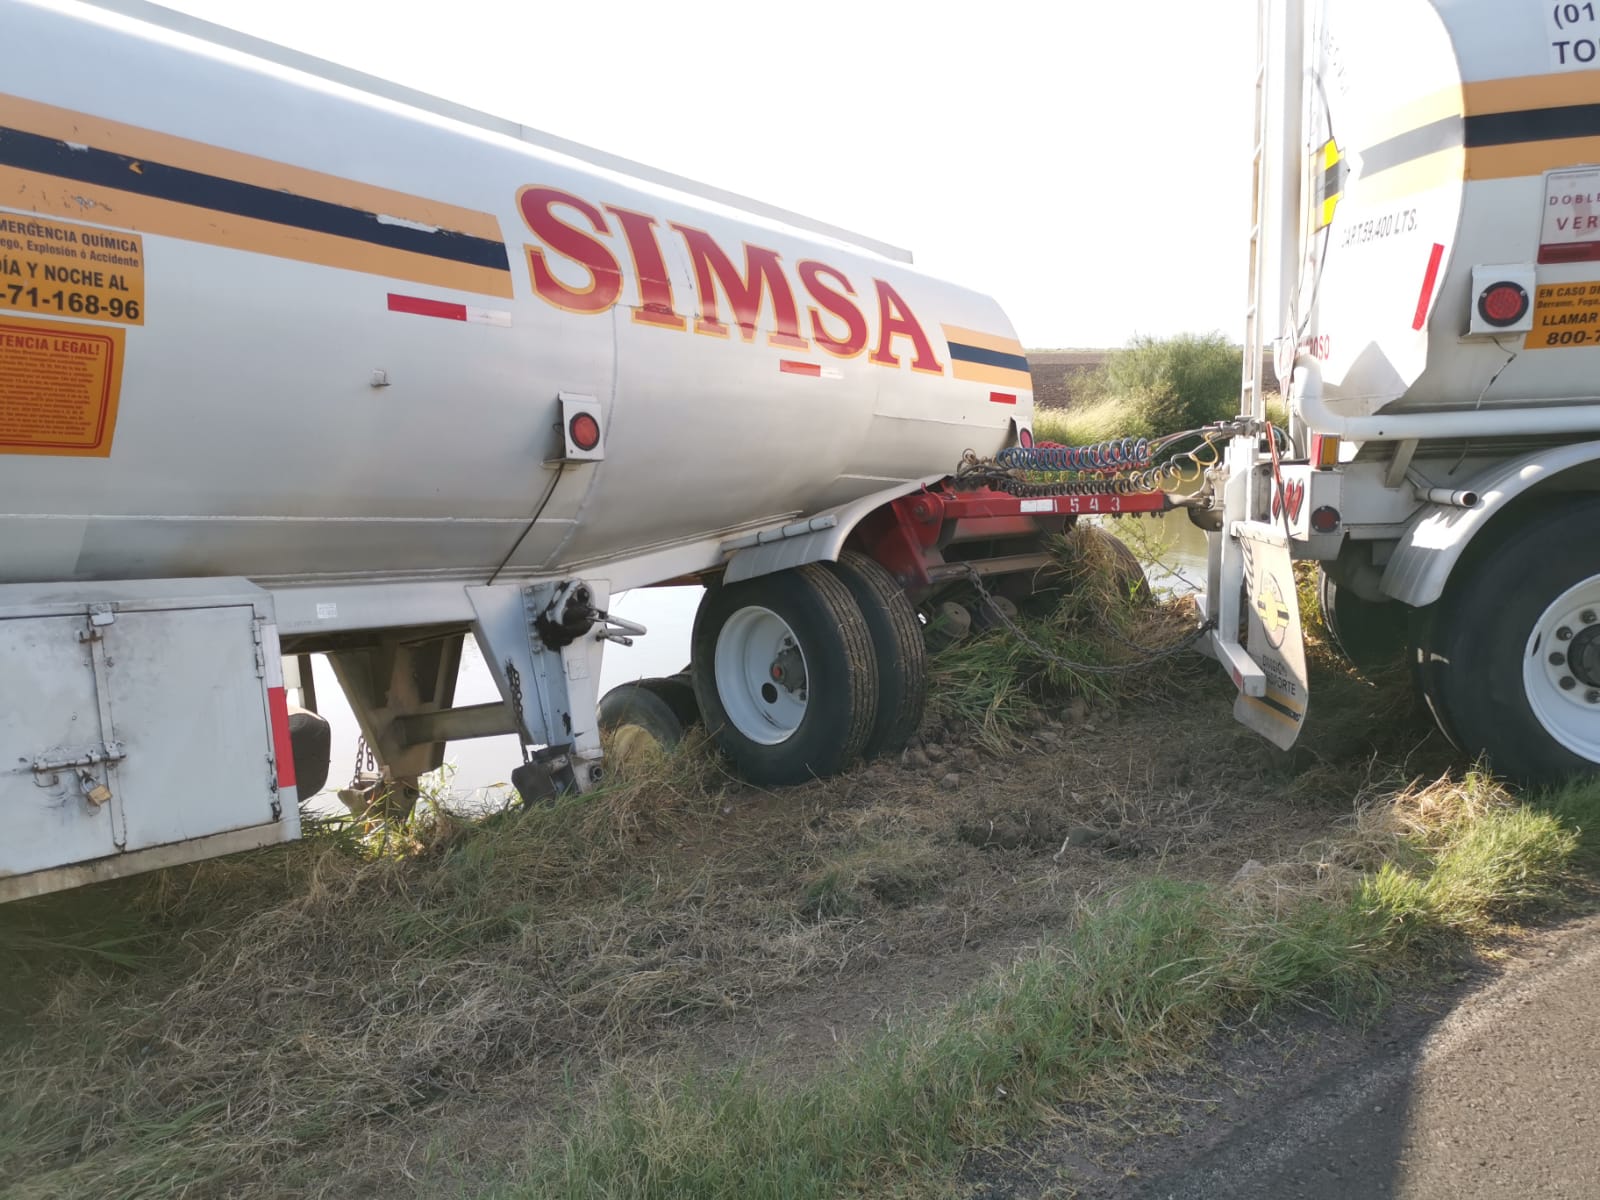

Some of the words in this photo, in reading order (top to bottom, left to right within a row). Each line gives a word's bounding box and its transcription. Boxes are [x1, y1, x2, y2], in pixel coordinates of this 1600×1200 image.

[1553, 1, 1596, 30] (01
[1552, 38, 1600, 65] TO
[1556, 215, 1598, 231] VER
[27, 241, 77, 258] Explosión
[90, 250, 139, 268] Accidente
[82, 232, 138, 253] QUÍMICA
[0, 254, 21, 277] ÍA
[26, 262, 38, 278] Y
[44, 264, 104, 288] NOCHE
[109, 274, 129, 291] AL
[515, 183, 944, 377] SIMSA
[0, 284, 139, 320] -71-168-96
[1539, 288, 1553, 298] EN
[1557, 286, 1586, 297] CASO
[1542, 312, 1598, 326] LLAMAR
[54, 340, 100, 356] LEGAL!
